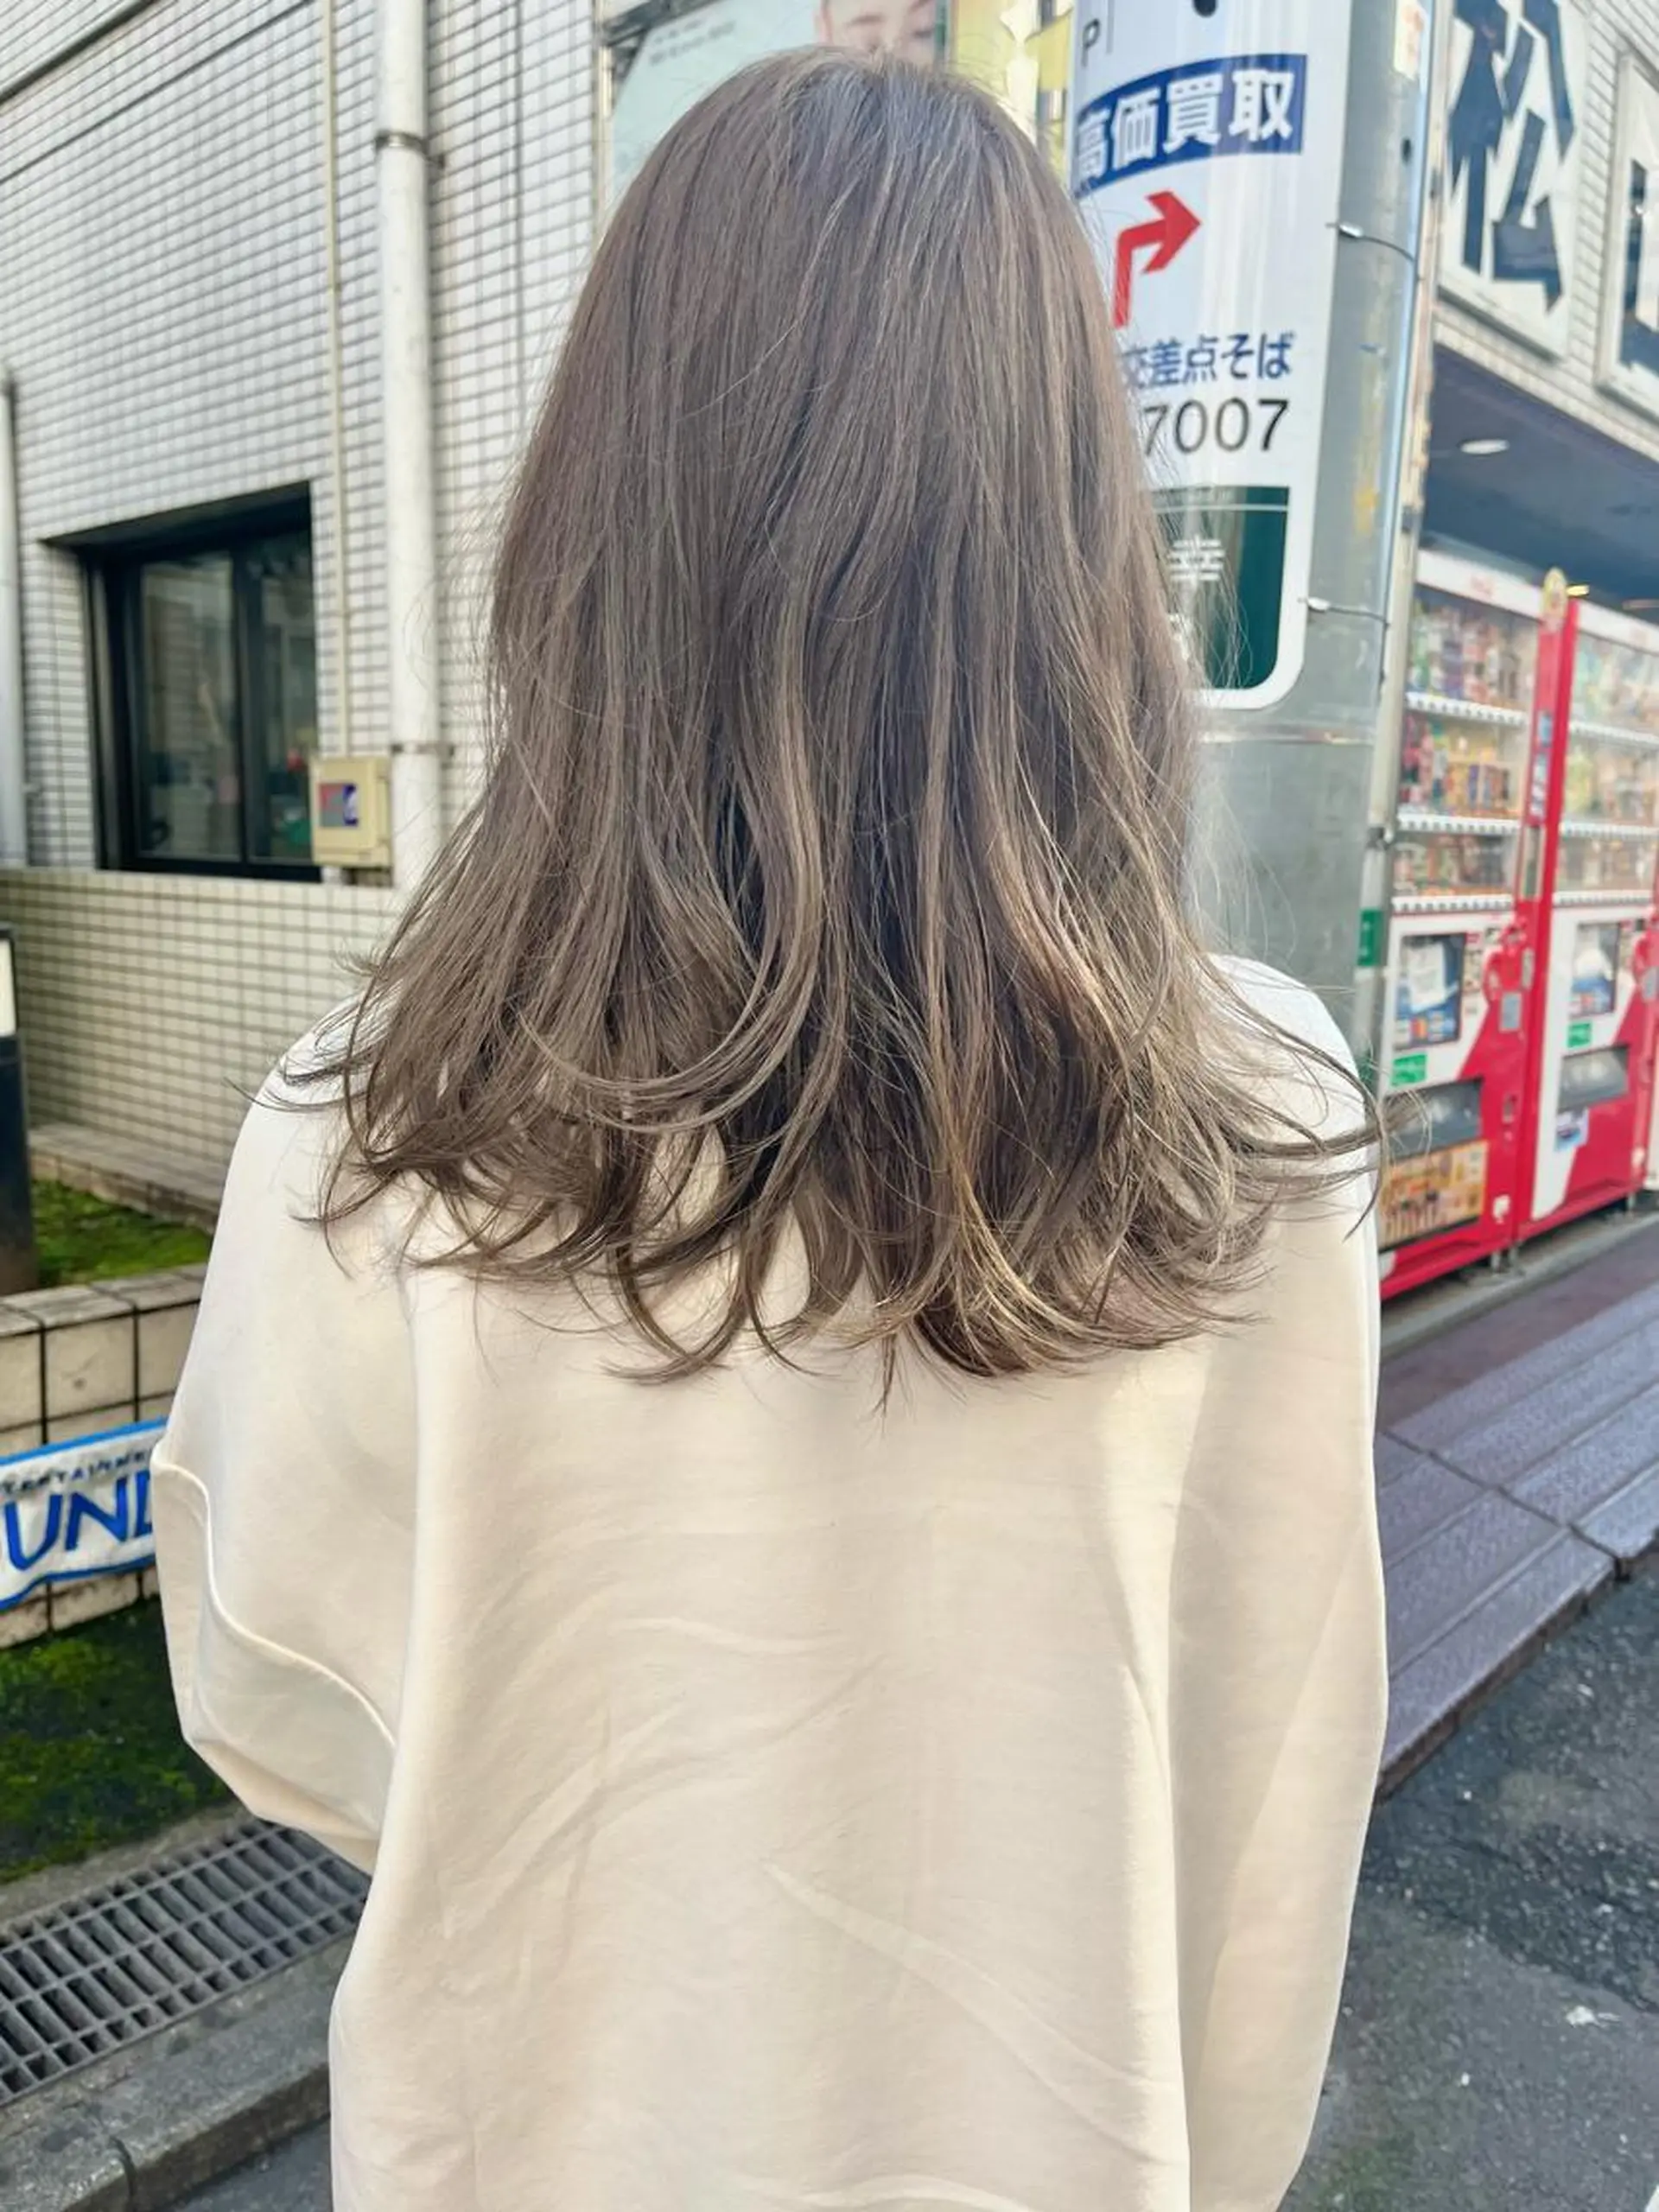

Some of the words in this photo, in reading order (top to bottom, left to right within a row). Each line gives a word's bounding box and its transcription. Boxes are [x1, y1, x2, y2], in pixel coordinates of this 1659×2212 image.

[1077, 69, 1295, 179] 高価買取
[1141, 397, 1290, 458] 7007
